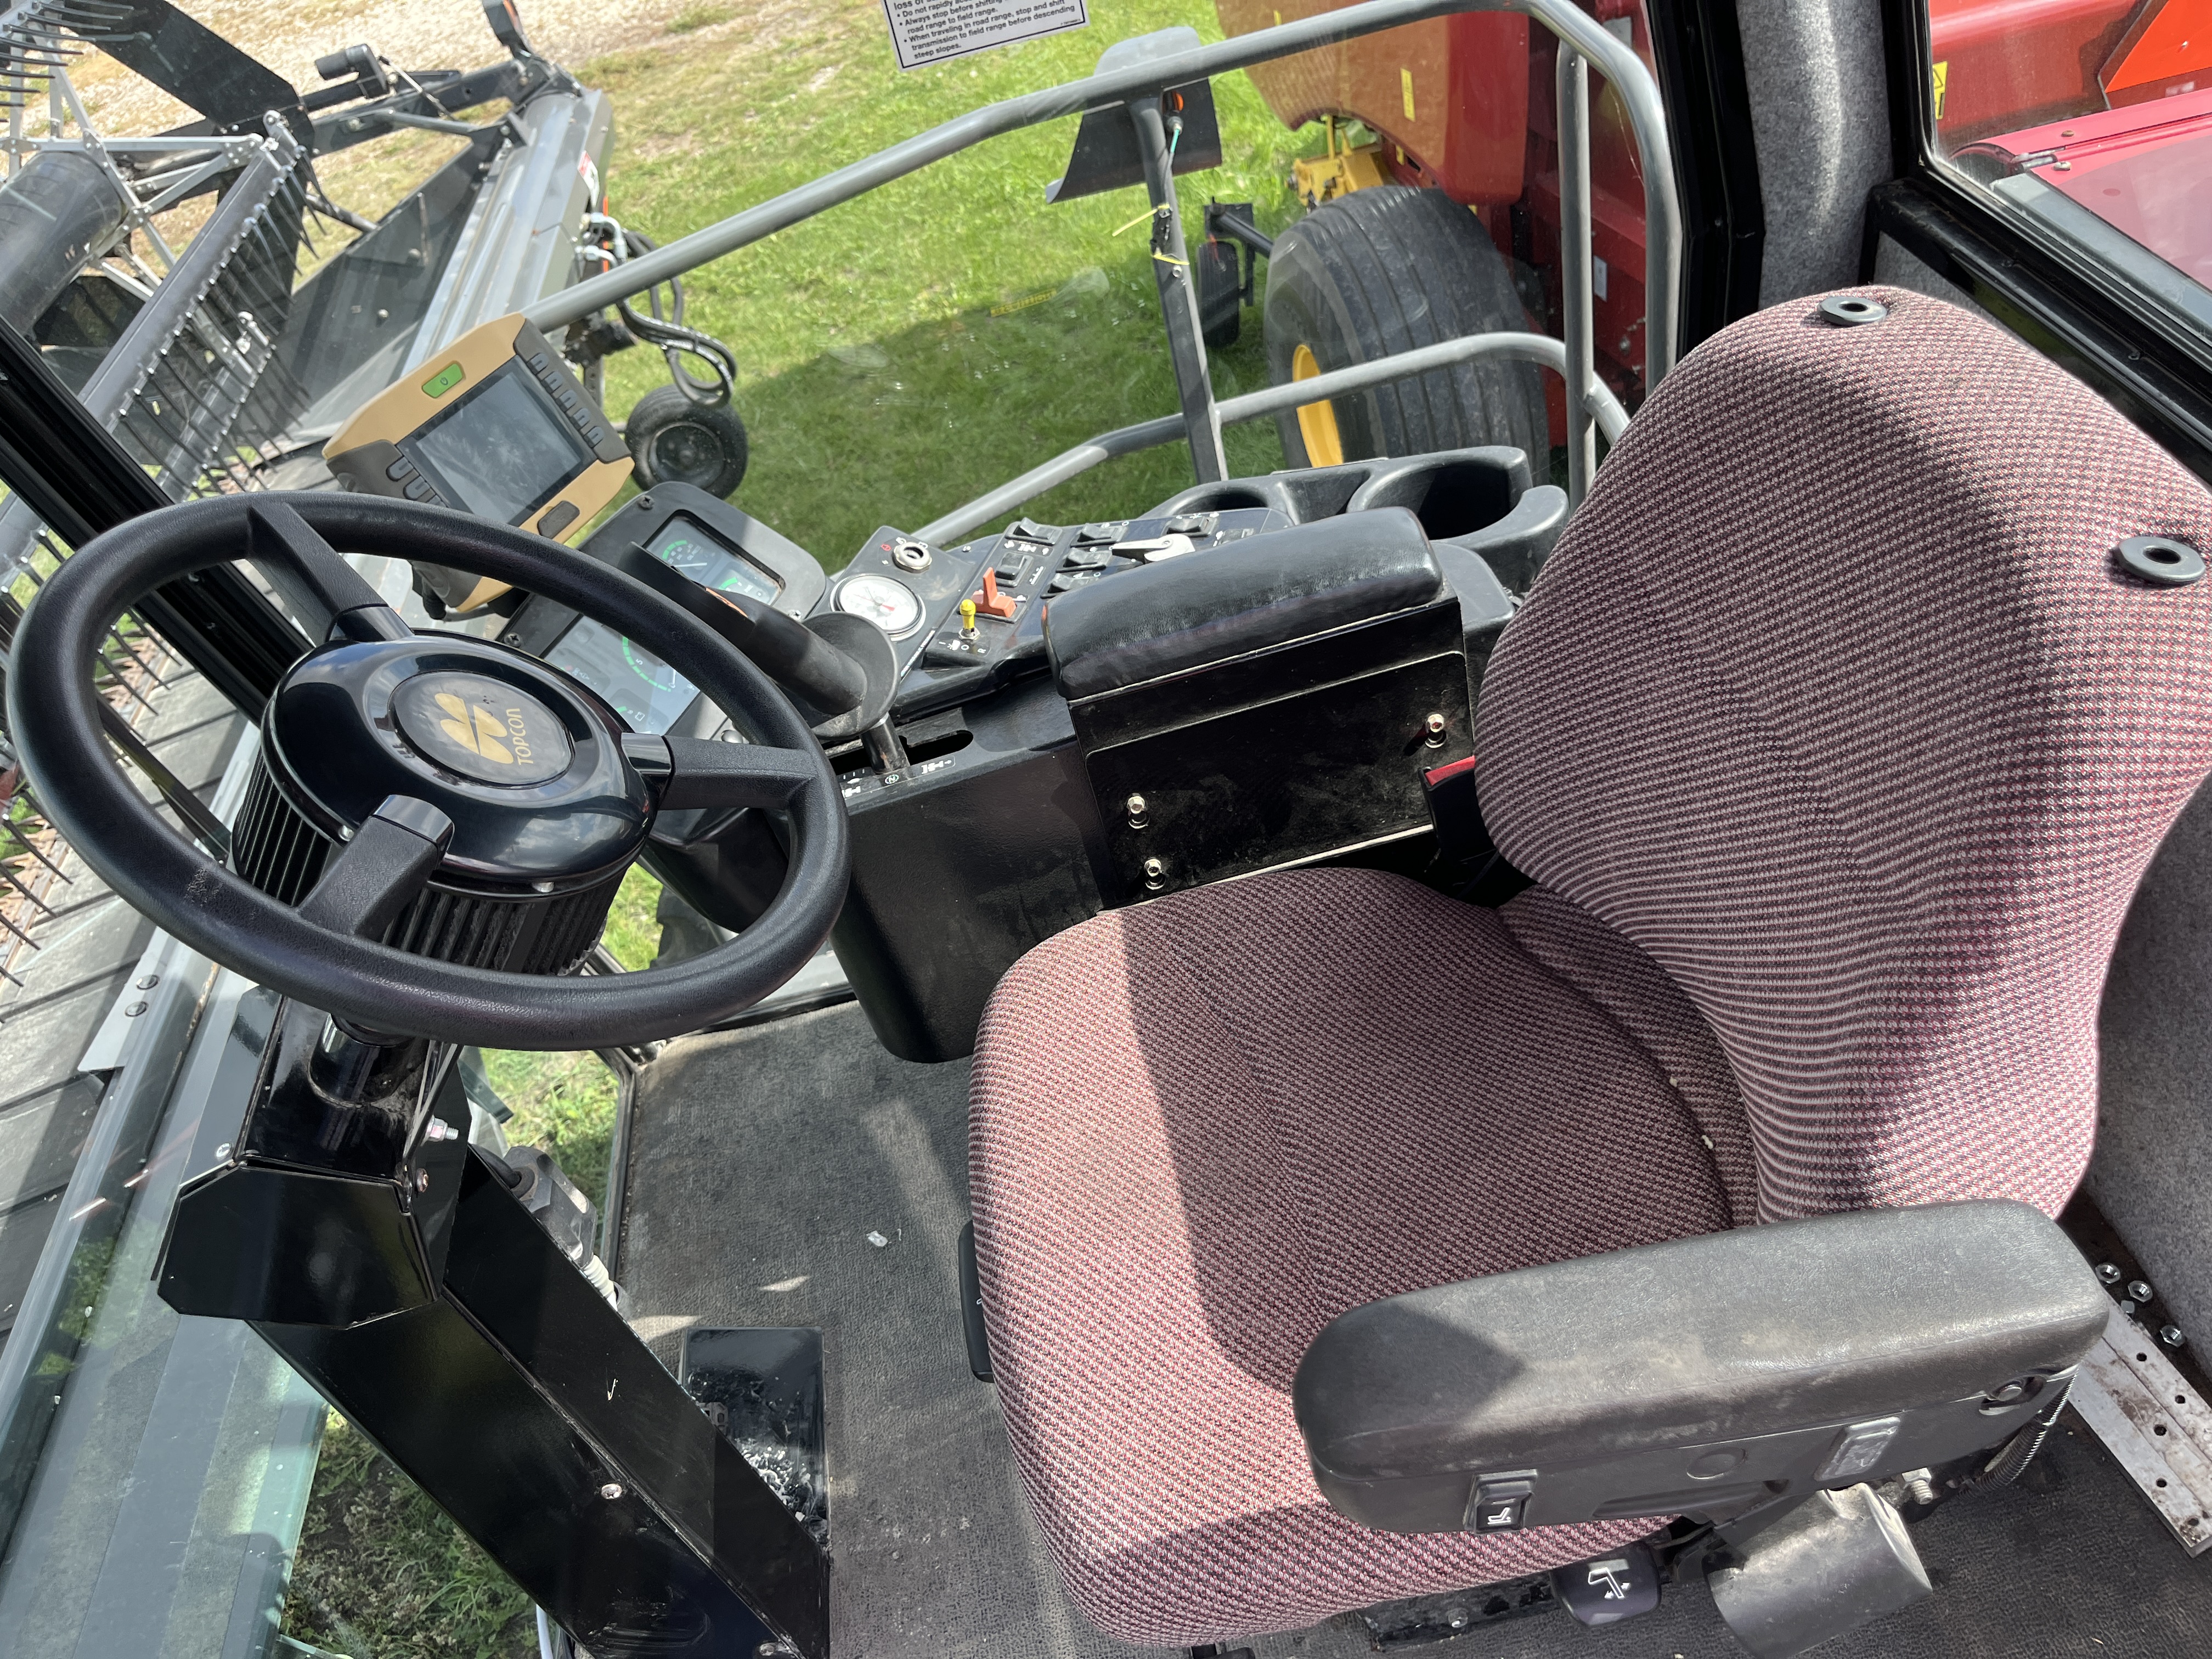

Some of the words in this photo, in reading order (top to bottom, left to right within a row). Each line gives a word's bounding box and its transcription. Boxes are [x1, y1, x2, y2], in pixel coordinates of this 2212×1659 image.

[894, 1, 913, 10] loss
[905, 15, 931, 26] Always
[950, 4, 974, 14] before
[907, 25, 924, 34] road
[926, 20, 946, 30] range
[957, 12, 973, 21] field
[975, 7, 998, 17] range.
[909, 33, 930, 42] When
[932, 25, 963, 37] traveling
[973, 17, 989, 26] road
[991, 12, 1014, 22] range,
[1015, 7, 1031, 15] stop
[1034, 2, 1047, 12] and
[912, 35, 958, 50] transmission
[969, 27, 985, 36] field
[986, 21, 1007, 32] range
[1008, 15, 1032, 26] before
[1034, 5, 1075, 20] descending
[914, 49, 934, 59] steep
[936, 43, 962, 54] slopes.
